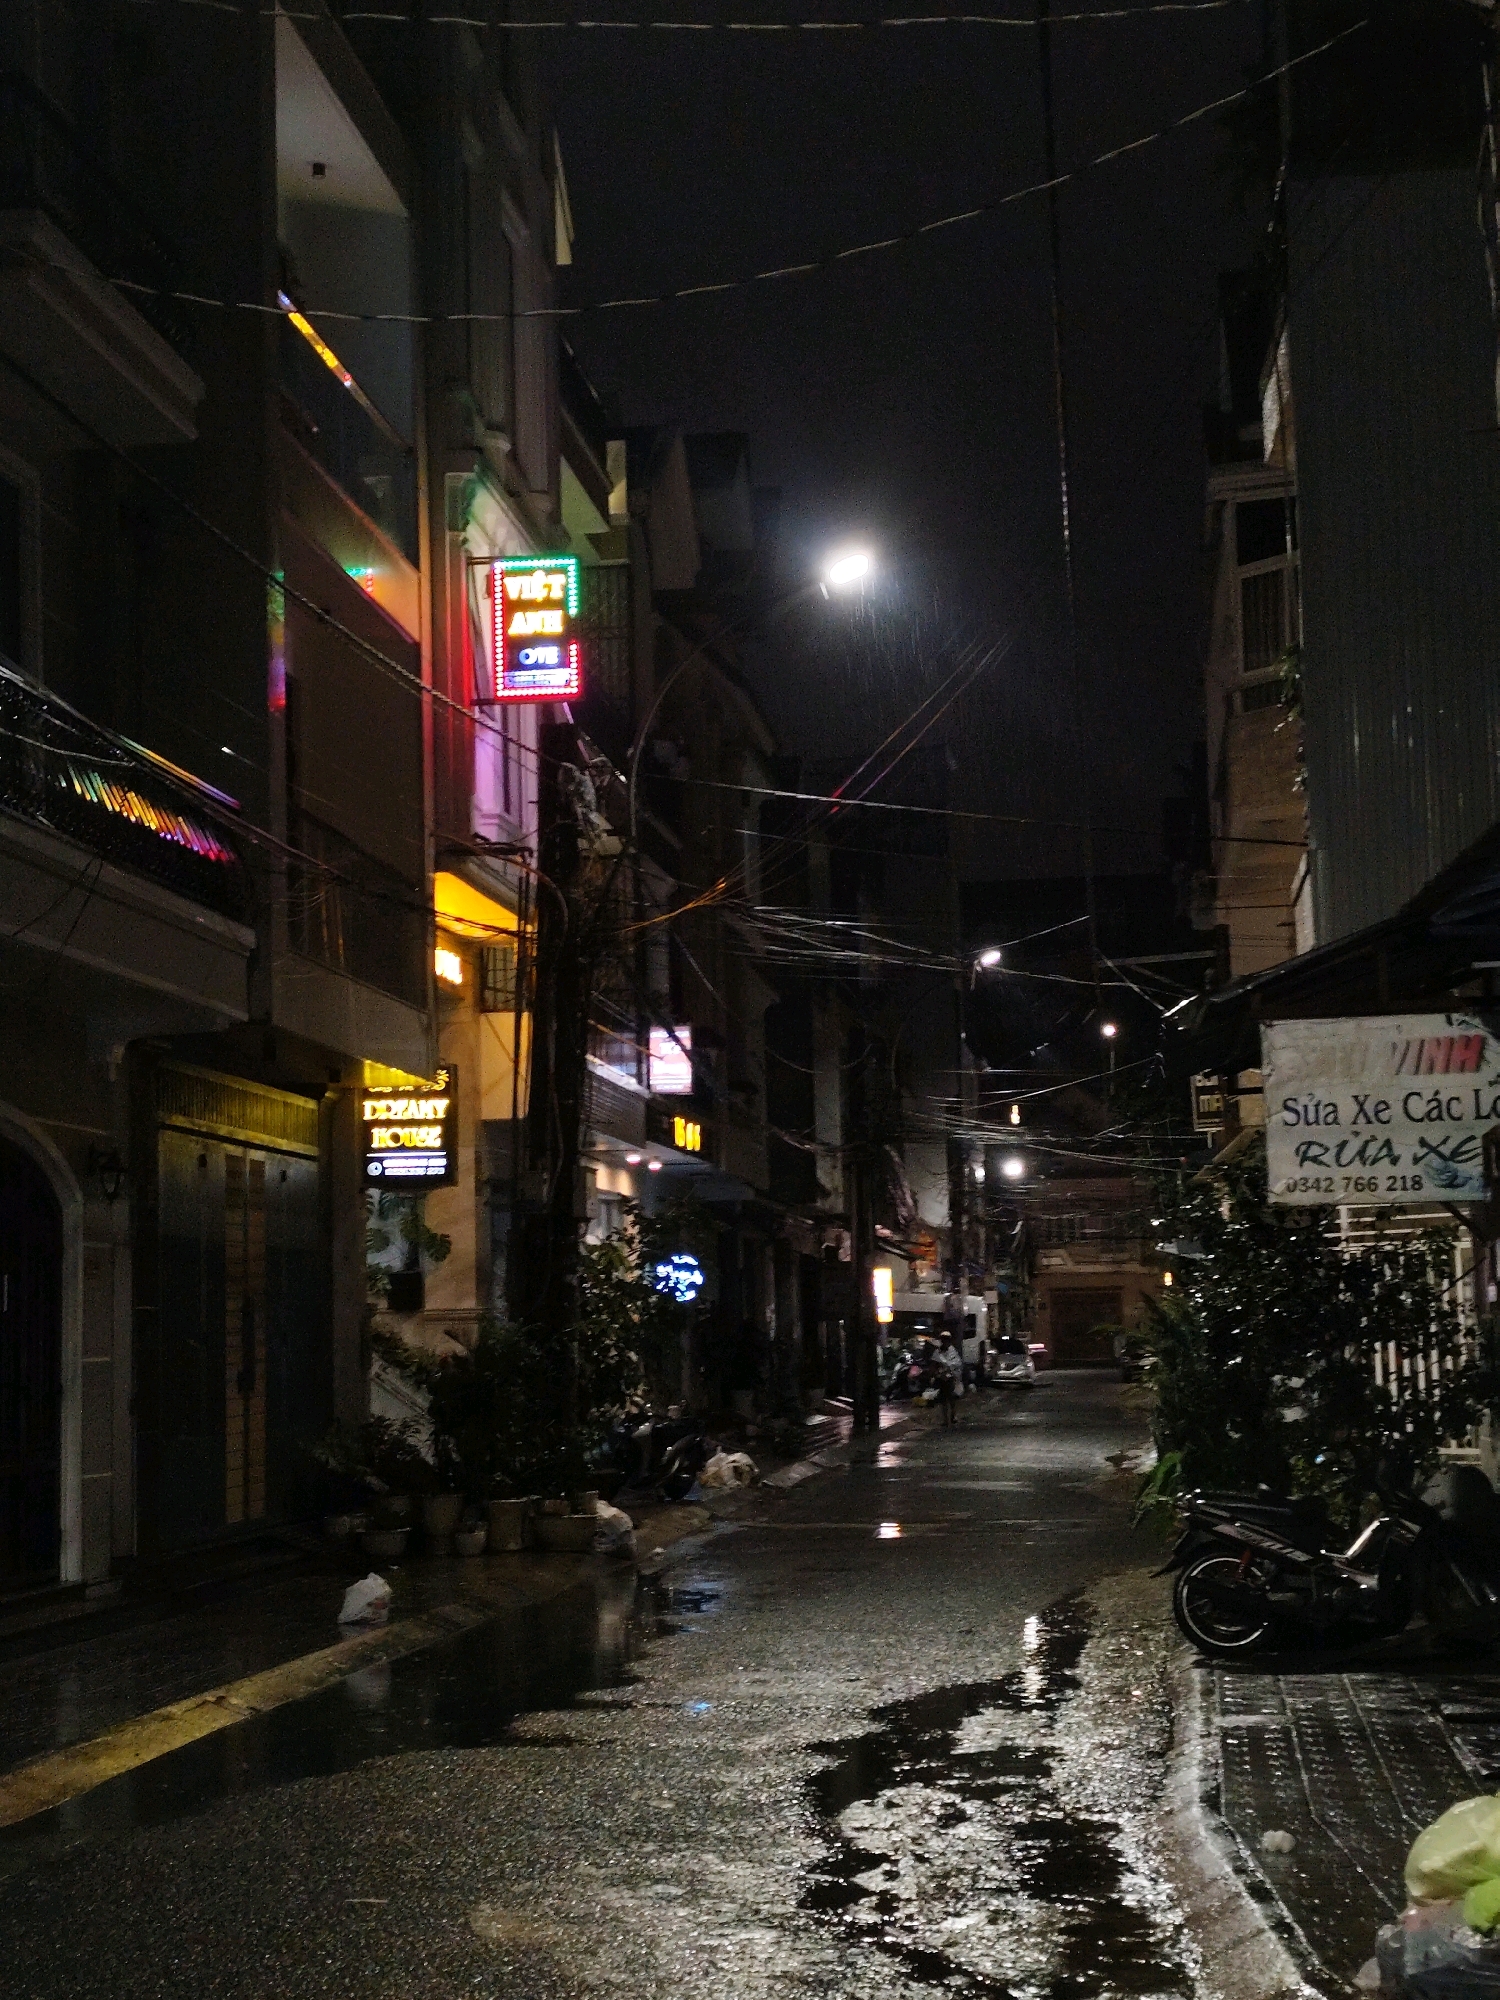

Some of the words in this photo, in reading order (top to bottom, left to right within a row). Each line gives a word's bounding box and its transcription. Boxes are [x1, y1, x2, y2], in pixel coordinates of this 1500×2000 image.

[504, 570, 566, 602] VIỆT
[507, 610, 563, 635] ANH
[362, 1099, 450, 1120] DREAMY
[1283, 1093, 1340, 1127] Sửa
[1351, 1094, 1390, 1125] Xe
[1402, 1089, 1463, 1123] Các
[371, 1126, 442, 1148] HOUSE
[1413, 1135, 1483, 1166] XE
[1286, 1176, 1335, 1194] 0342
[1343, 1176, 1379, 1193] 766
[1386, 1175, 1423, 1192] 218
